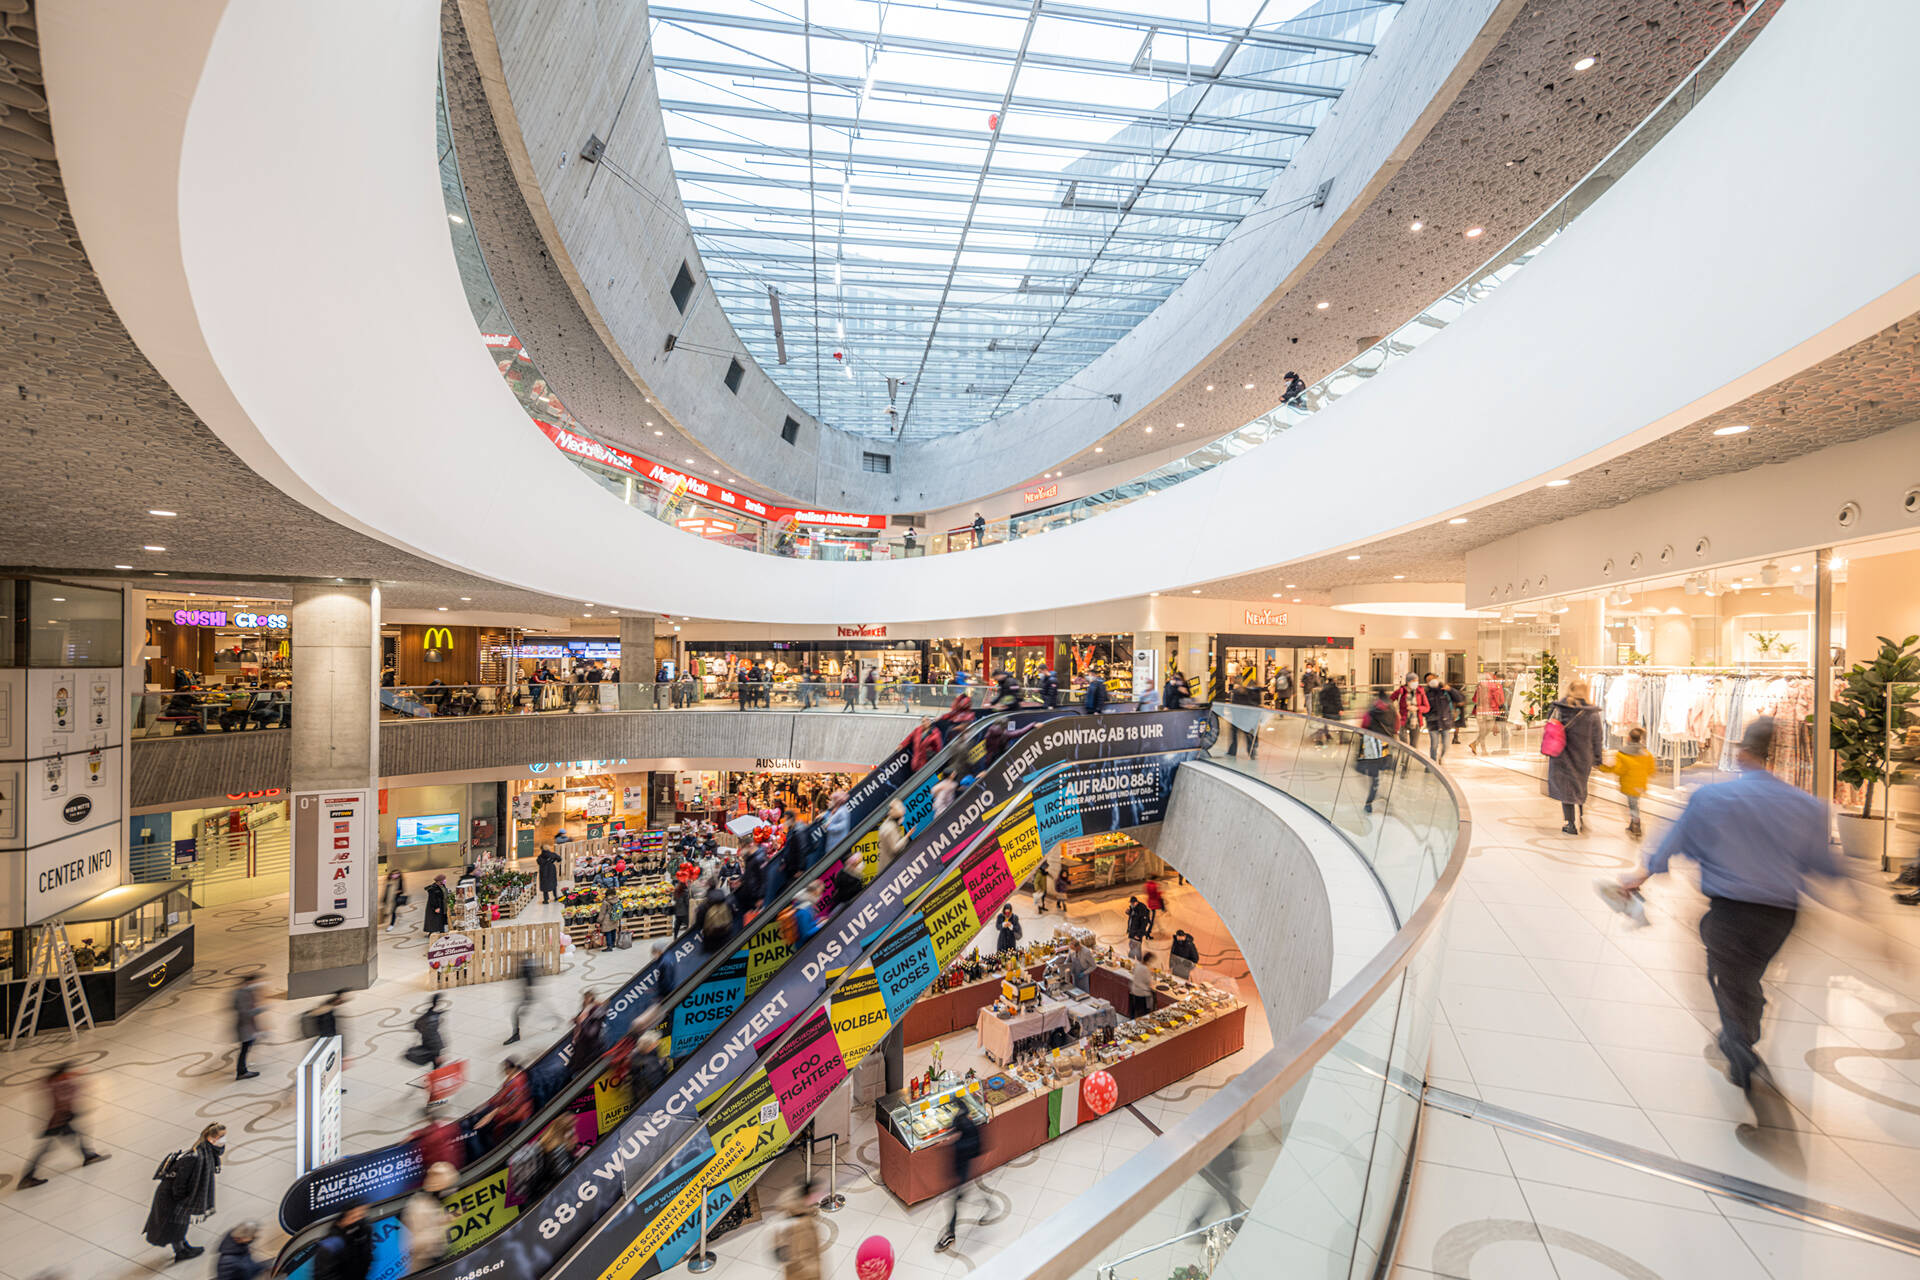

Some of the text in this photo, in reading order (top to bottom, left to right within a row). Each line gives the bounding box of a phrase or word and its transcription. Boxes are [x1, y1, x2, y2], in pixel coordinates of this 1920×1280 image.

[174, 610, 227, 626] SUSHI
[756, 758, 801, 768] AUSGANG
[1002, 741, 1044, 791] JEDEN
[1043, 729, 1107, 751] SONNTAG
[1108, 727, 1124, 741] AB
[1126, 726, 1139, 740] 18
[1140, 724, 1163, 738] UHR
[863, 752, 910, 798] IM RADIO
[1065, 781, 1092, 797] AUF
[1092, 775, 1129, 793] RADIO
[1130, 772, 1154, 787] 88.6
[905, 799, 934, 831] MAID
[1040, 805, 1078, 832] MAIDEN
[1009, 837, 1038, 862] HOSEN
[39, 849, 112, 893] CENTER INFO
[968, 862, 1000, 891] BLACK
[973, 869, 1011, 905] ABBATH
[930, 899, 968, 937] LINKIN
[936, 916, 971, 950] PARK
[749, 928, 782, 950] LINK
[754, 943, 795, 967] PARK
[882, 954, 917, 983] GUNS
[606, 968, 661, 1021] SONNTA
[674, 941, 695, 962] AB
[890, 962, 930, 996] ROSES
[682, 990, 724, 1009] GUNS
[538, 1180, 599, 1240] 88.6
[592, 989, 789, 1181] WUNSCHKONZERT
[801, 939, 842, 983] DAS
[839, 851, 932, 945] LIVE-EVENT
[926, 838, 951, 862] IM
[947, 790, 995, 840] RADIO
[684, 1005, 733, 1025] ROSES
[833, 1008, 888, 1034] VOLBEAT
[779, 1055, 841, 1106] FIGHTERS
[791, 1054, 821, 1080] FOO
[605, 1107, 622, 1120] AUF
[722, 1080, 771, 1117] WUNSCHKONZE
[791, 1107, 806, 1120] AUF
[317, 1154, 423, 1196] AUF RADIO 88.6
[325, 1191, 340, 1201] DER
[364, 1178, 379, 1188] WEB
[380, 1174, 394, 1184] UND
[445, 1179, 507, 1218] REEN
[640, 1204, 679, 1244] SCANNEN
[685, 1183, 701, 1199] MIT
[700, 1157, 725, 1185] RADIO
[725, 1140, 742, 1157] 88.6
[446, 1205, 495, 1245] DAY
